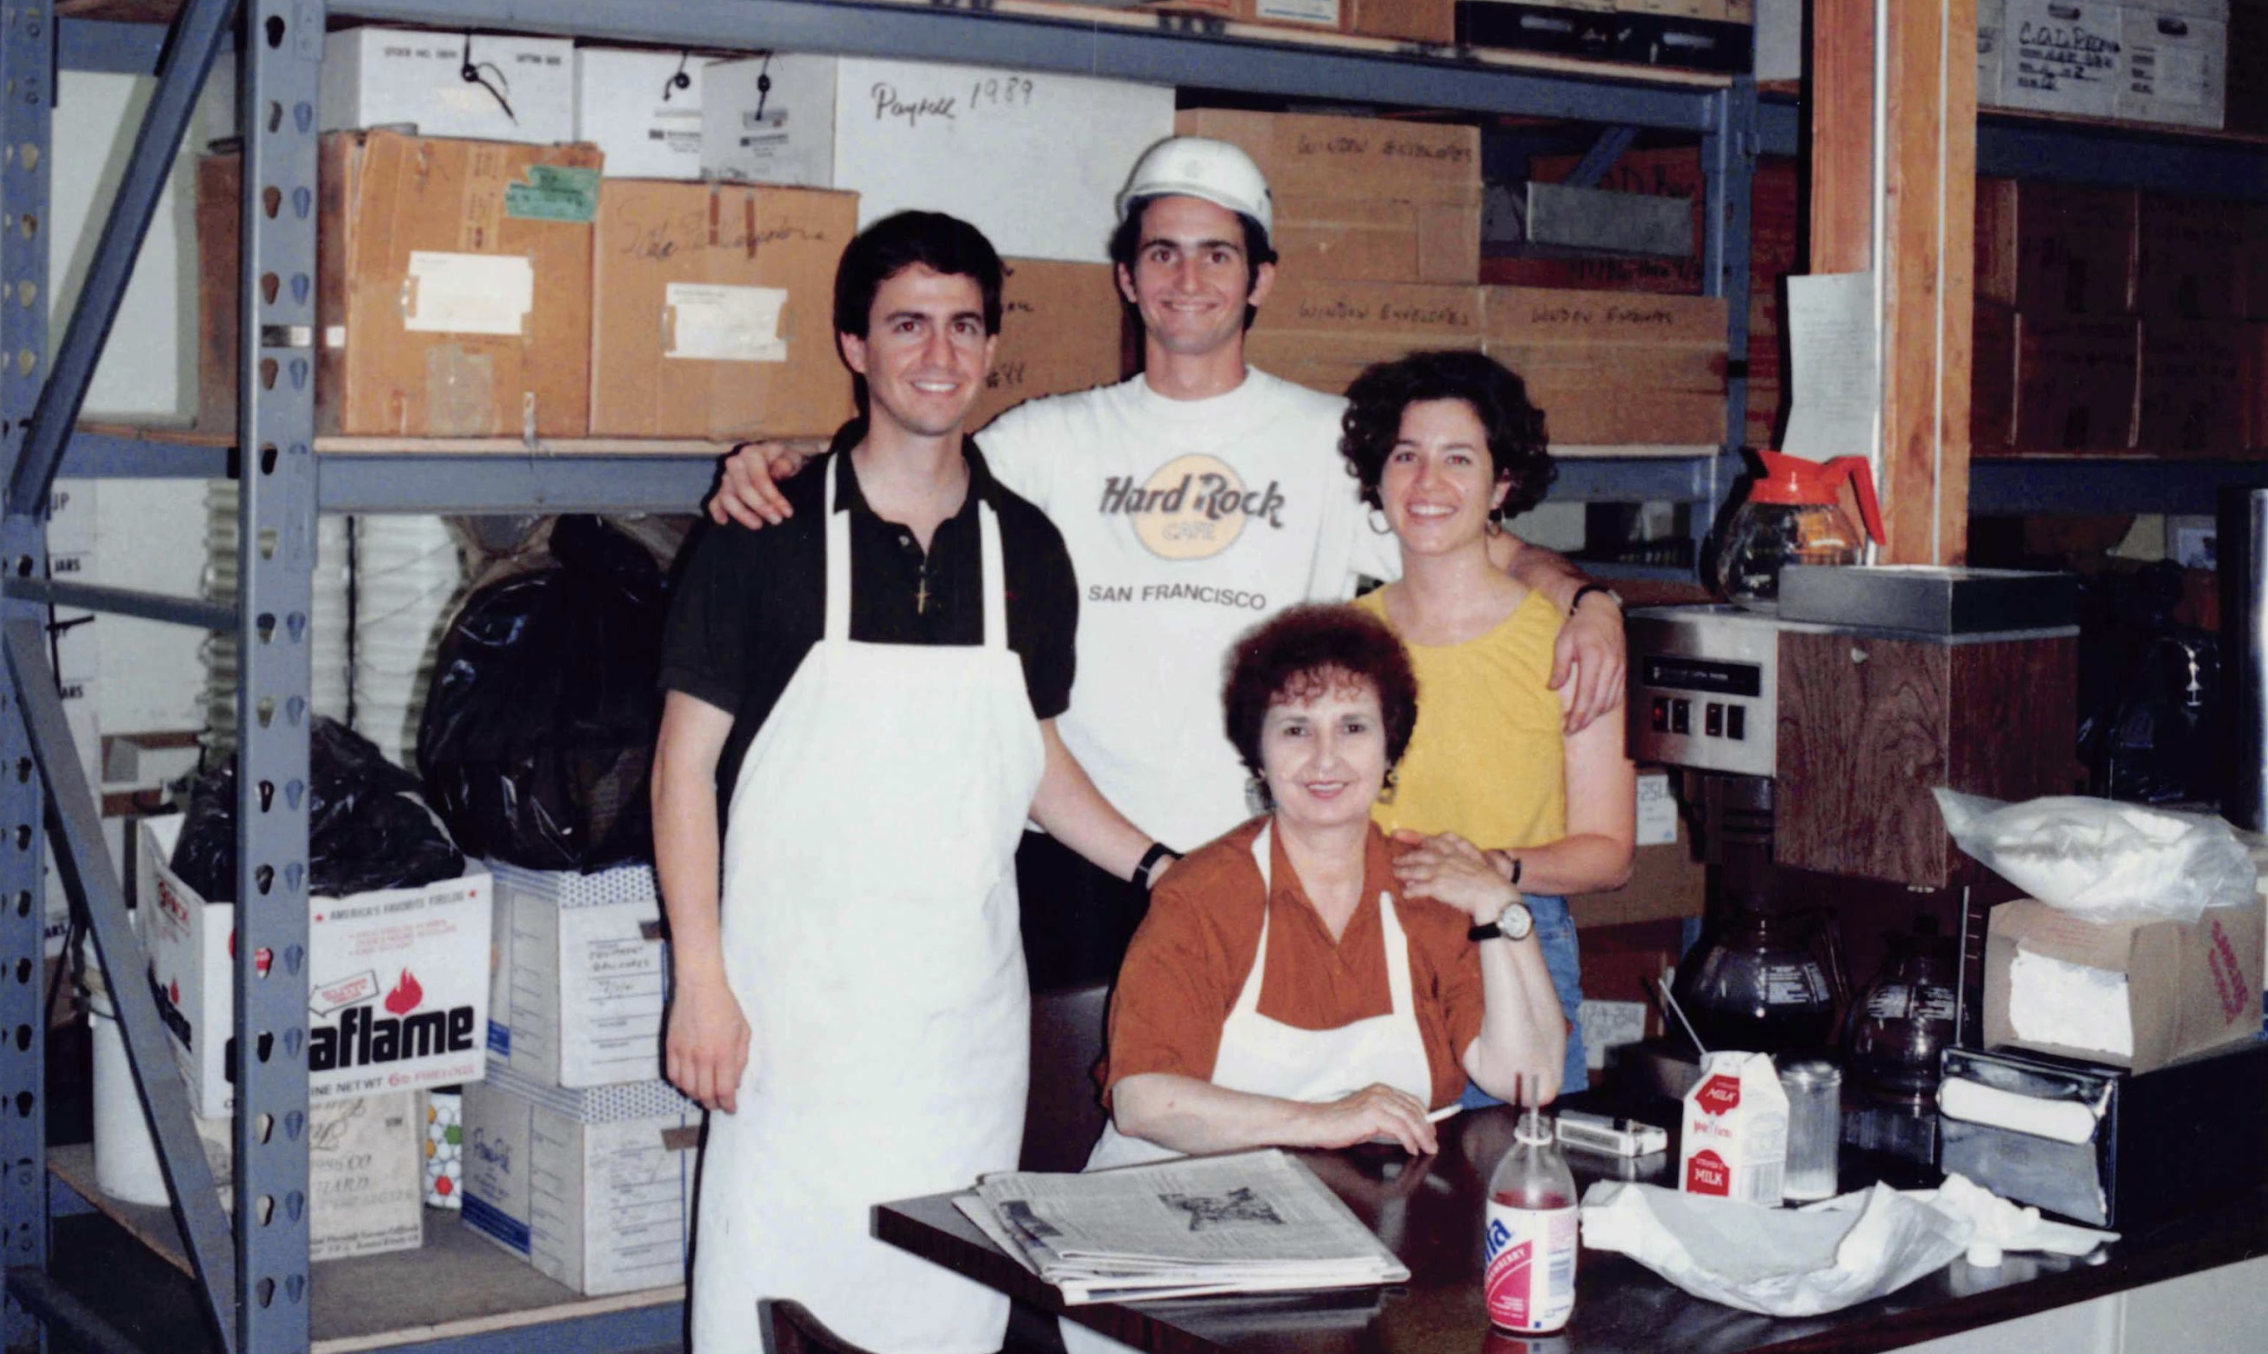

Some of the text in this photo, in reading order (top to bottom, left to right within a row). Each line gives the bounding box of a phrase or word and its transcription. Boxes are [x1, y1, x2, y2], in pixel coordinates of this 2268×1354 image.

[969, 76, 1034, 110] 1989
[1098, 471, 1287, 531] Hard Rock
[54, 558, 81, 573] JARS
[1087, 582, 1267, 611] SAN FRANCISCO
[60, 685, 84, 700] ARS
[329, 905, 381, 921] AMERICA'S
[384, 898, 425, 914] FAVORITE
[308, 1005, 475, 1072] aflame
[310, 1085, 333, 1096] INE
[336, 1080, 361, 1093] NET
[363, 1077, 383, 1089] WT
[1705, 1088, 1737, 1103] MILK
[1694, 1167, 1723, 1187] MILK
